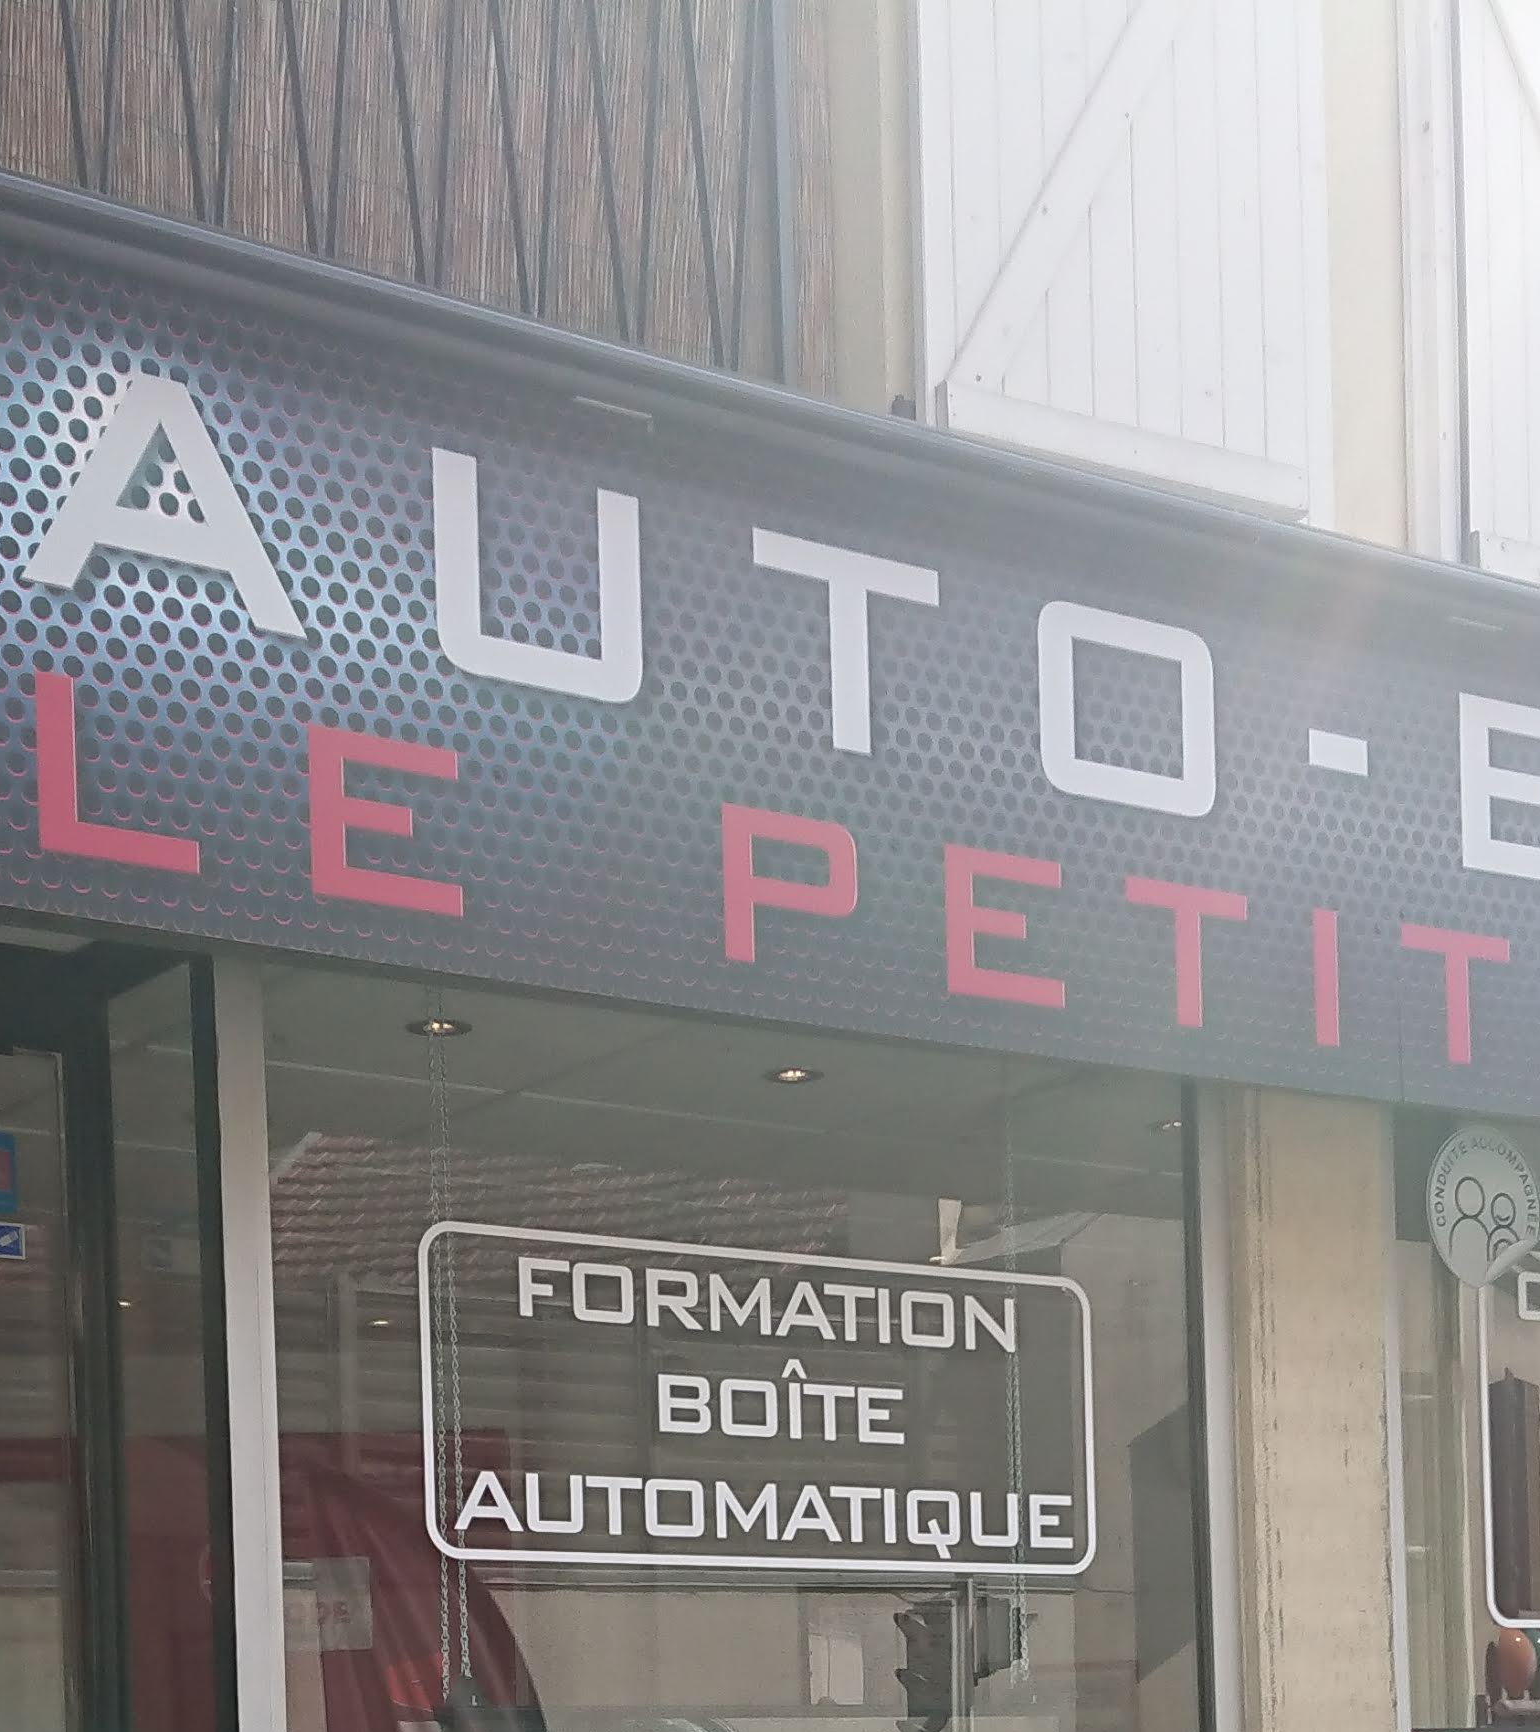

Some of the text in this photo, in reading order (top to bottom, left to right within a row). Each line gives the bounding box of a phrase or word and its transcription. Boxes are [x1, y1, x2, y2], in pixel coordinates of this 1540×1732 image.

[35, 671, 463, 918] LE
[721, 803, 1511, 1065] PETIT
[1434, 1140, 1468, 1228] CONDUITE
[517, 1255, 1016, 1354] FORMATION
[657, 1358, 905, 1445] BOÎTE
[454, 1470, 1075, 1560] AUTOMATIQUE
